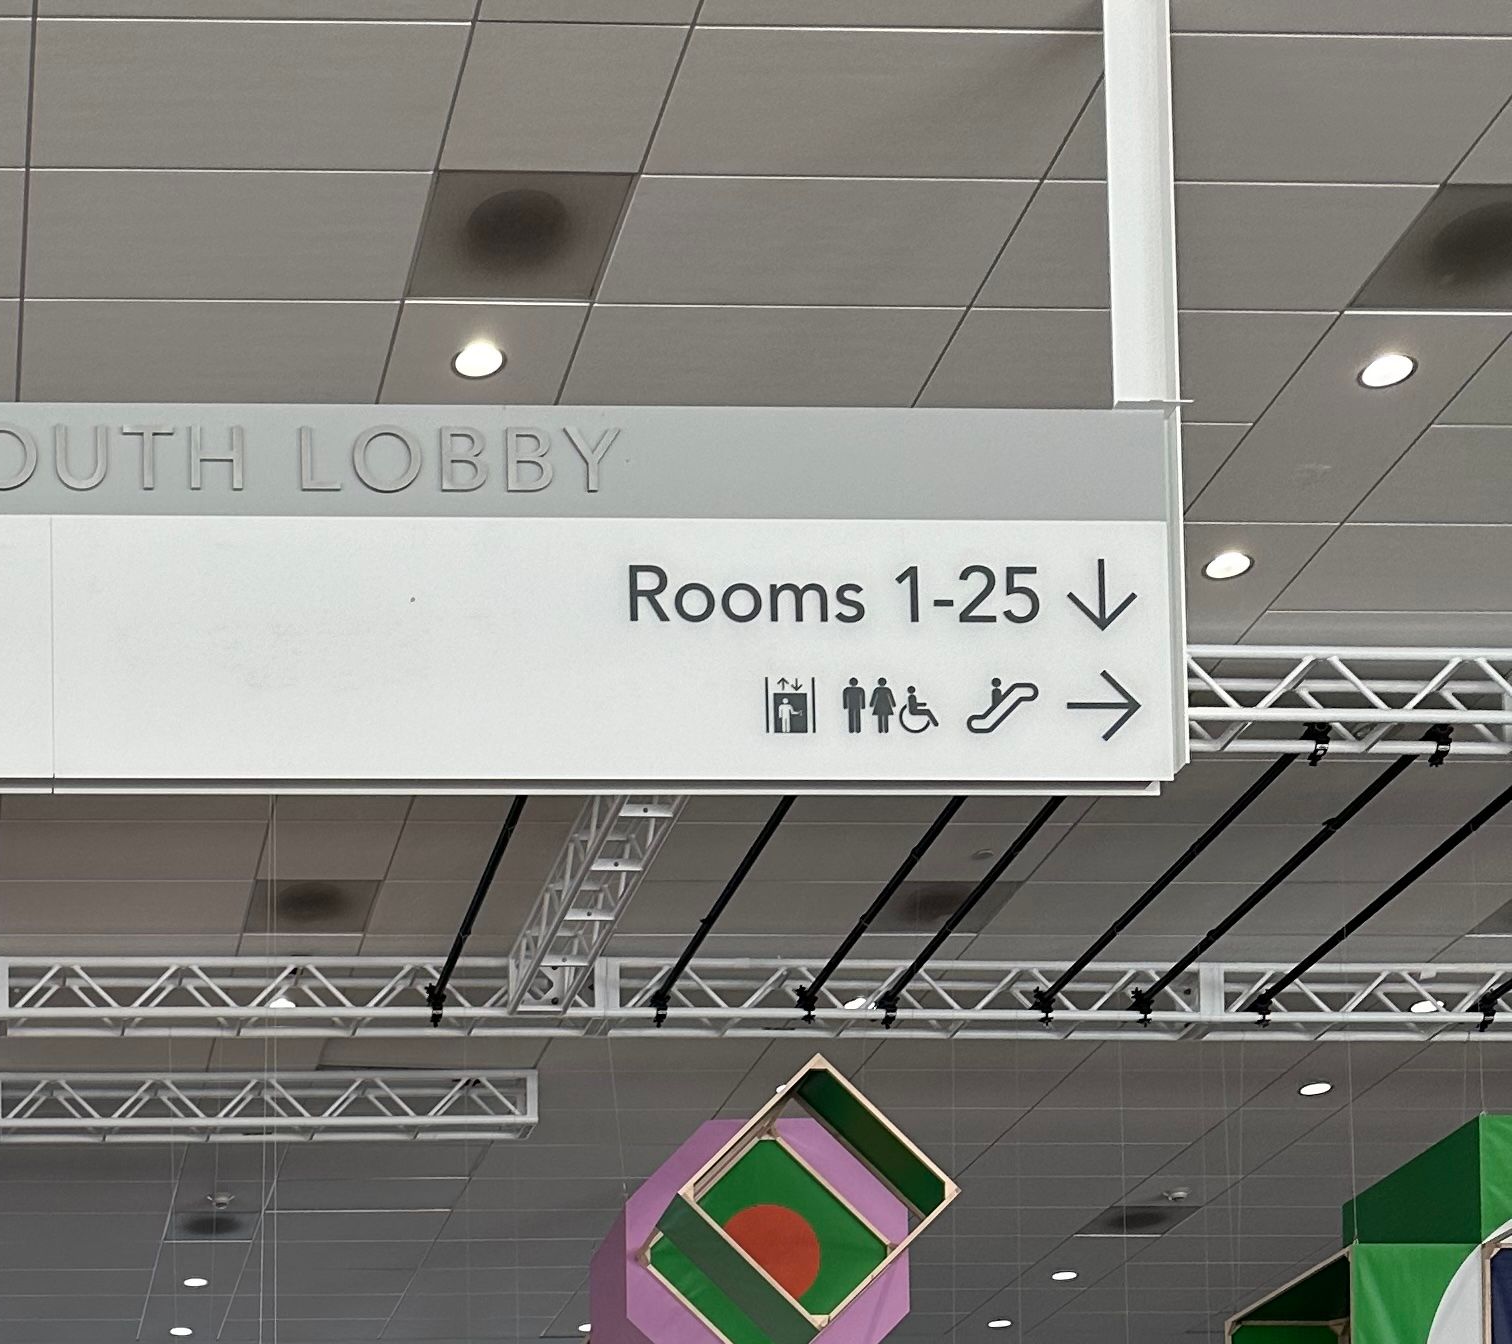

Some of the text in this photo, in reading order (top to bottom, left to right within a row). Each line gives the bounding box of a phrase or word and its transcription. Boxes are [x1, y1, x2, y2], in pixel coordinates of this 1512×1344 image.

[300, 423, 622, 494] LOBBY
[629, 565, 1039, 623] Rooms 1-25
